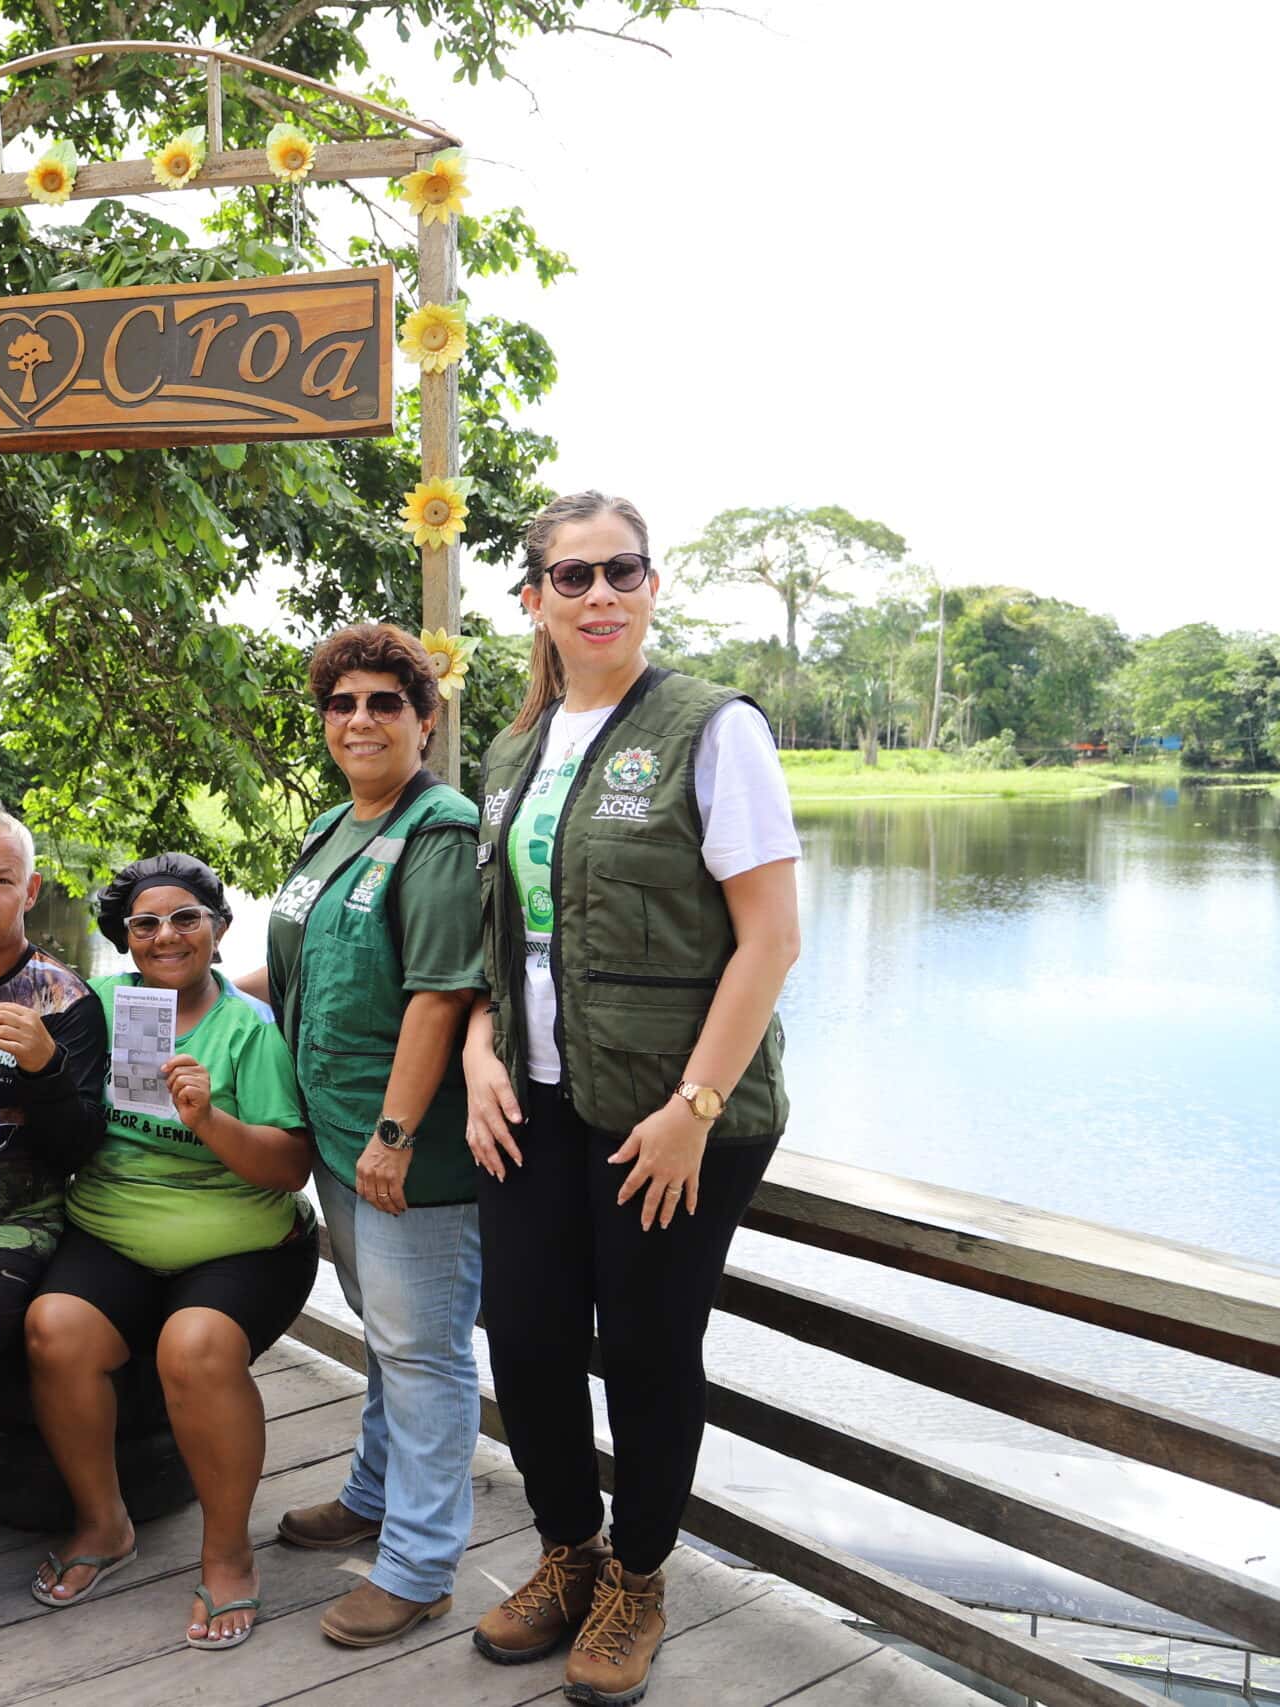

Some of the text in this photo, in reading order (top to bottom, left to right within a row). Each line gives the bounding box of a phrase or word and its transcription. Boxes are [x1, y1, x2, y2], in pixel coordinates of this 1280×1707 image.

[103, 304, 369, 403] Croa
[594, 800, 650, 818] ACRE
[600, 794, 651, 805] GOVERNO DO
[105, 1108, 138, 1129] ABOR
[142, 1120, 152, 1133] &
